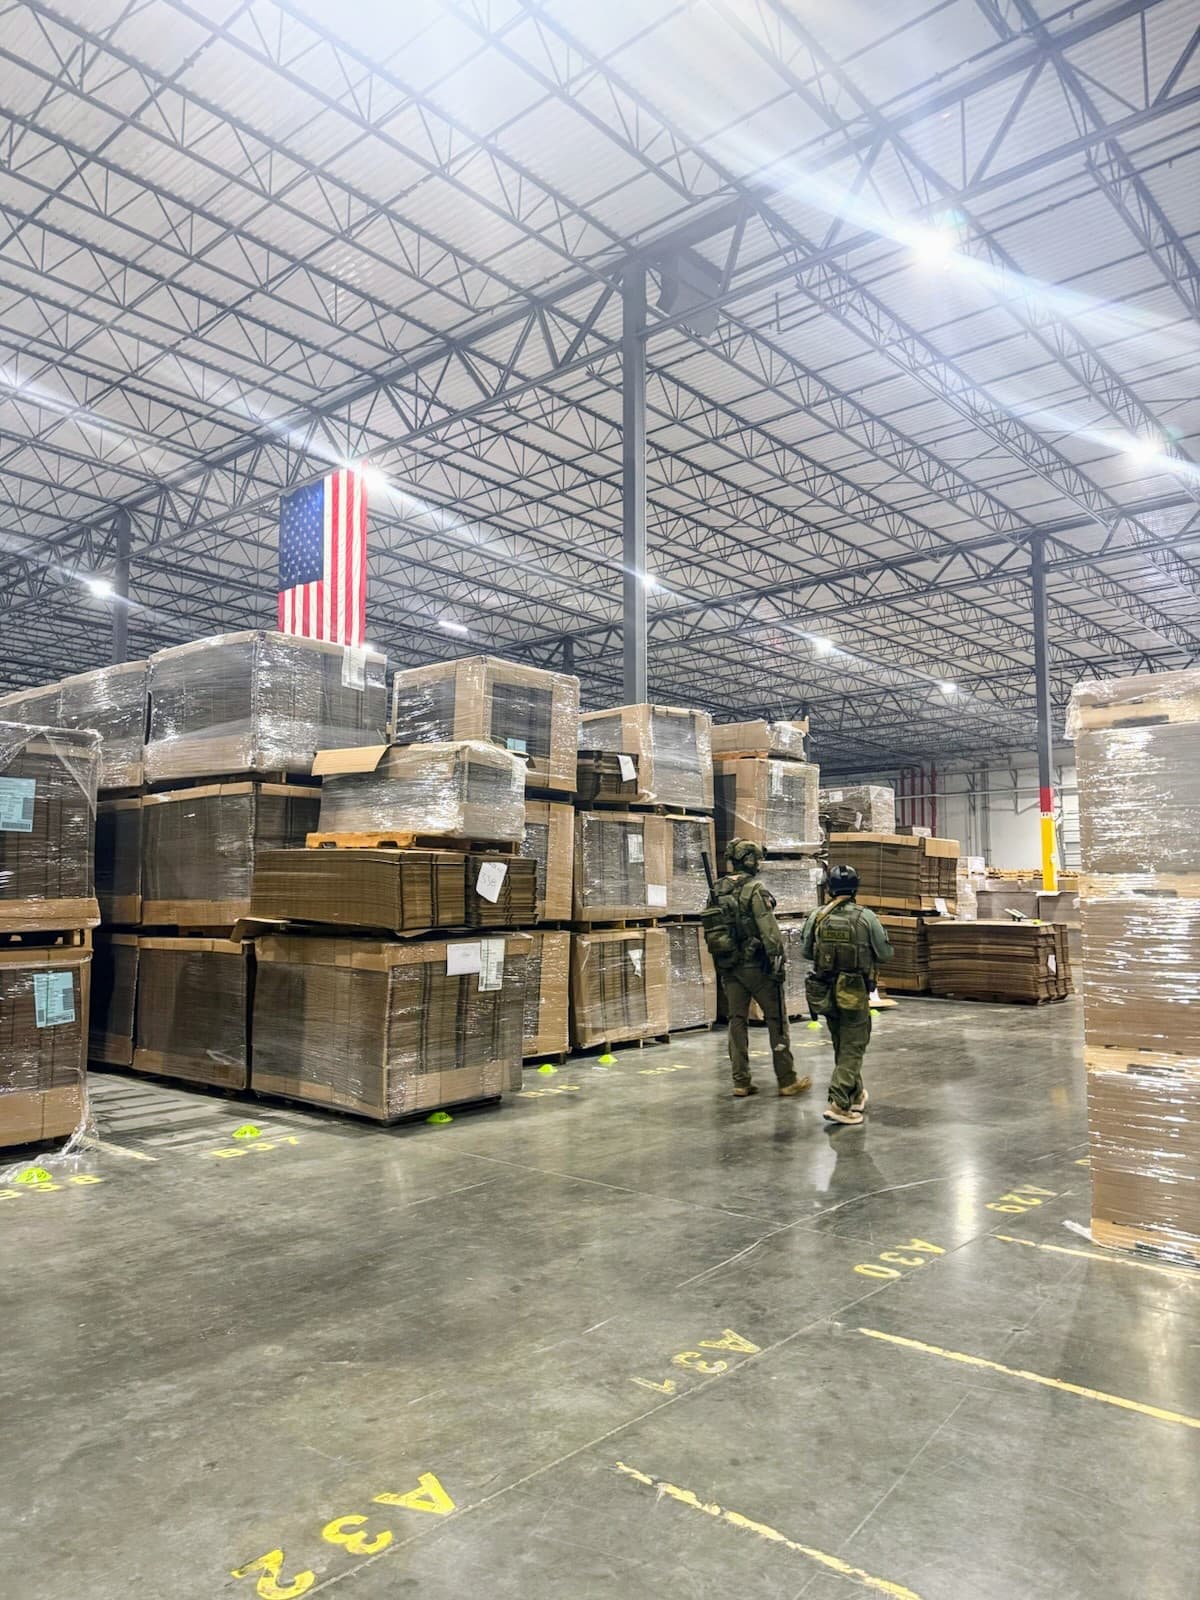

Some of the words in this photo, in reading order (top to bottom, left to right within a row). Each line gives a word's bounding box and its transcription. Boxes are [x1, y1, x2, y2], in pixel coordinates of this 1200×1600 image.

[210, 1135, 299, 1158] B37
[985, 1184, 1058, 1213] A29
[853, 1238, 946, 1279] A30
[231, 1472, 456, 1600] A32
